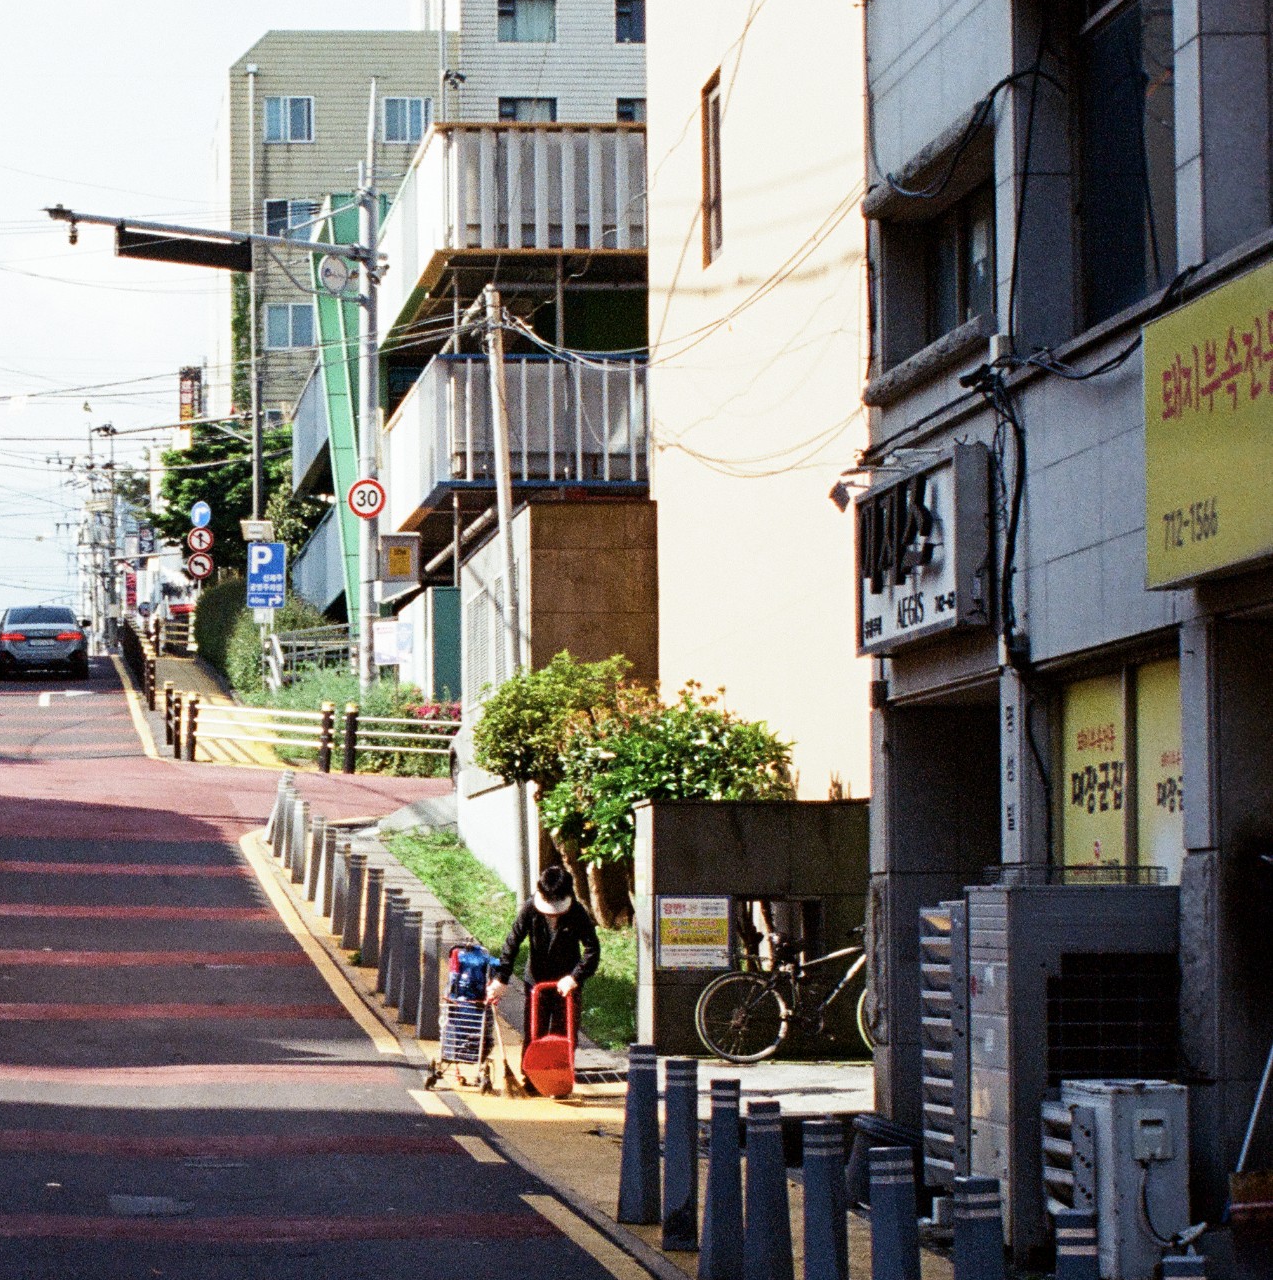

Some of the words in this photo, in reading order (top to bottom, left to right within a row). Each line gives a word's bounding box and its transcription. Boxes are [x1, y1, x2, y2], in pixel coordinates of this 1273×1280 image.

[1162, 308, 1273, 421] 돼지부속전
[356, 490, 378, 507] 30
[1163, 497, 1218, 551] 712-1566
[251, 546, 273, 574] P
[896, 592, 924, 629] AEGIS
